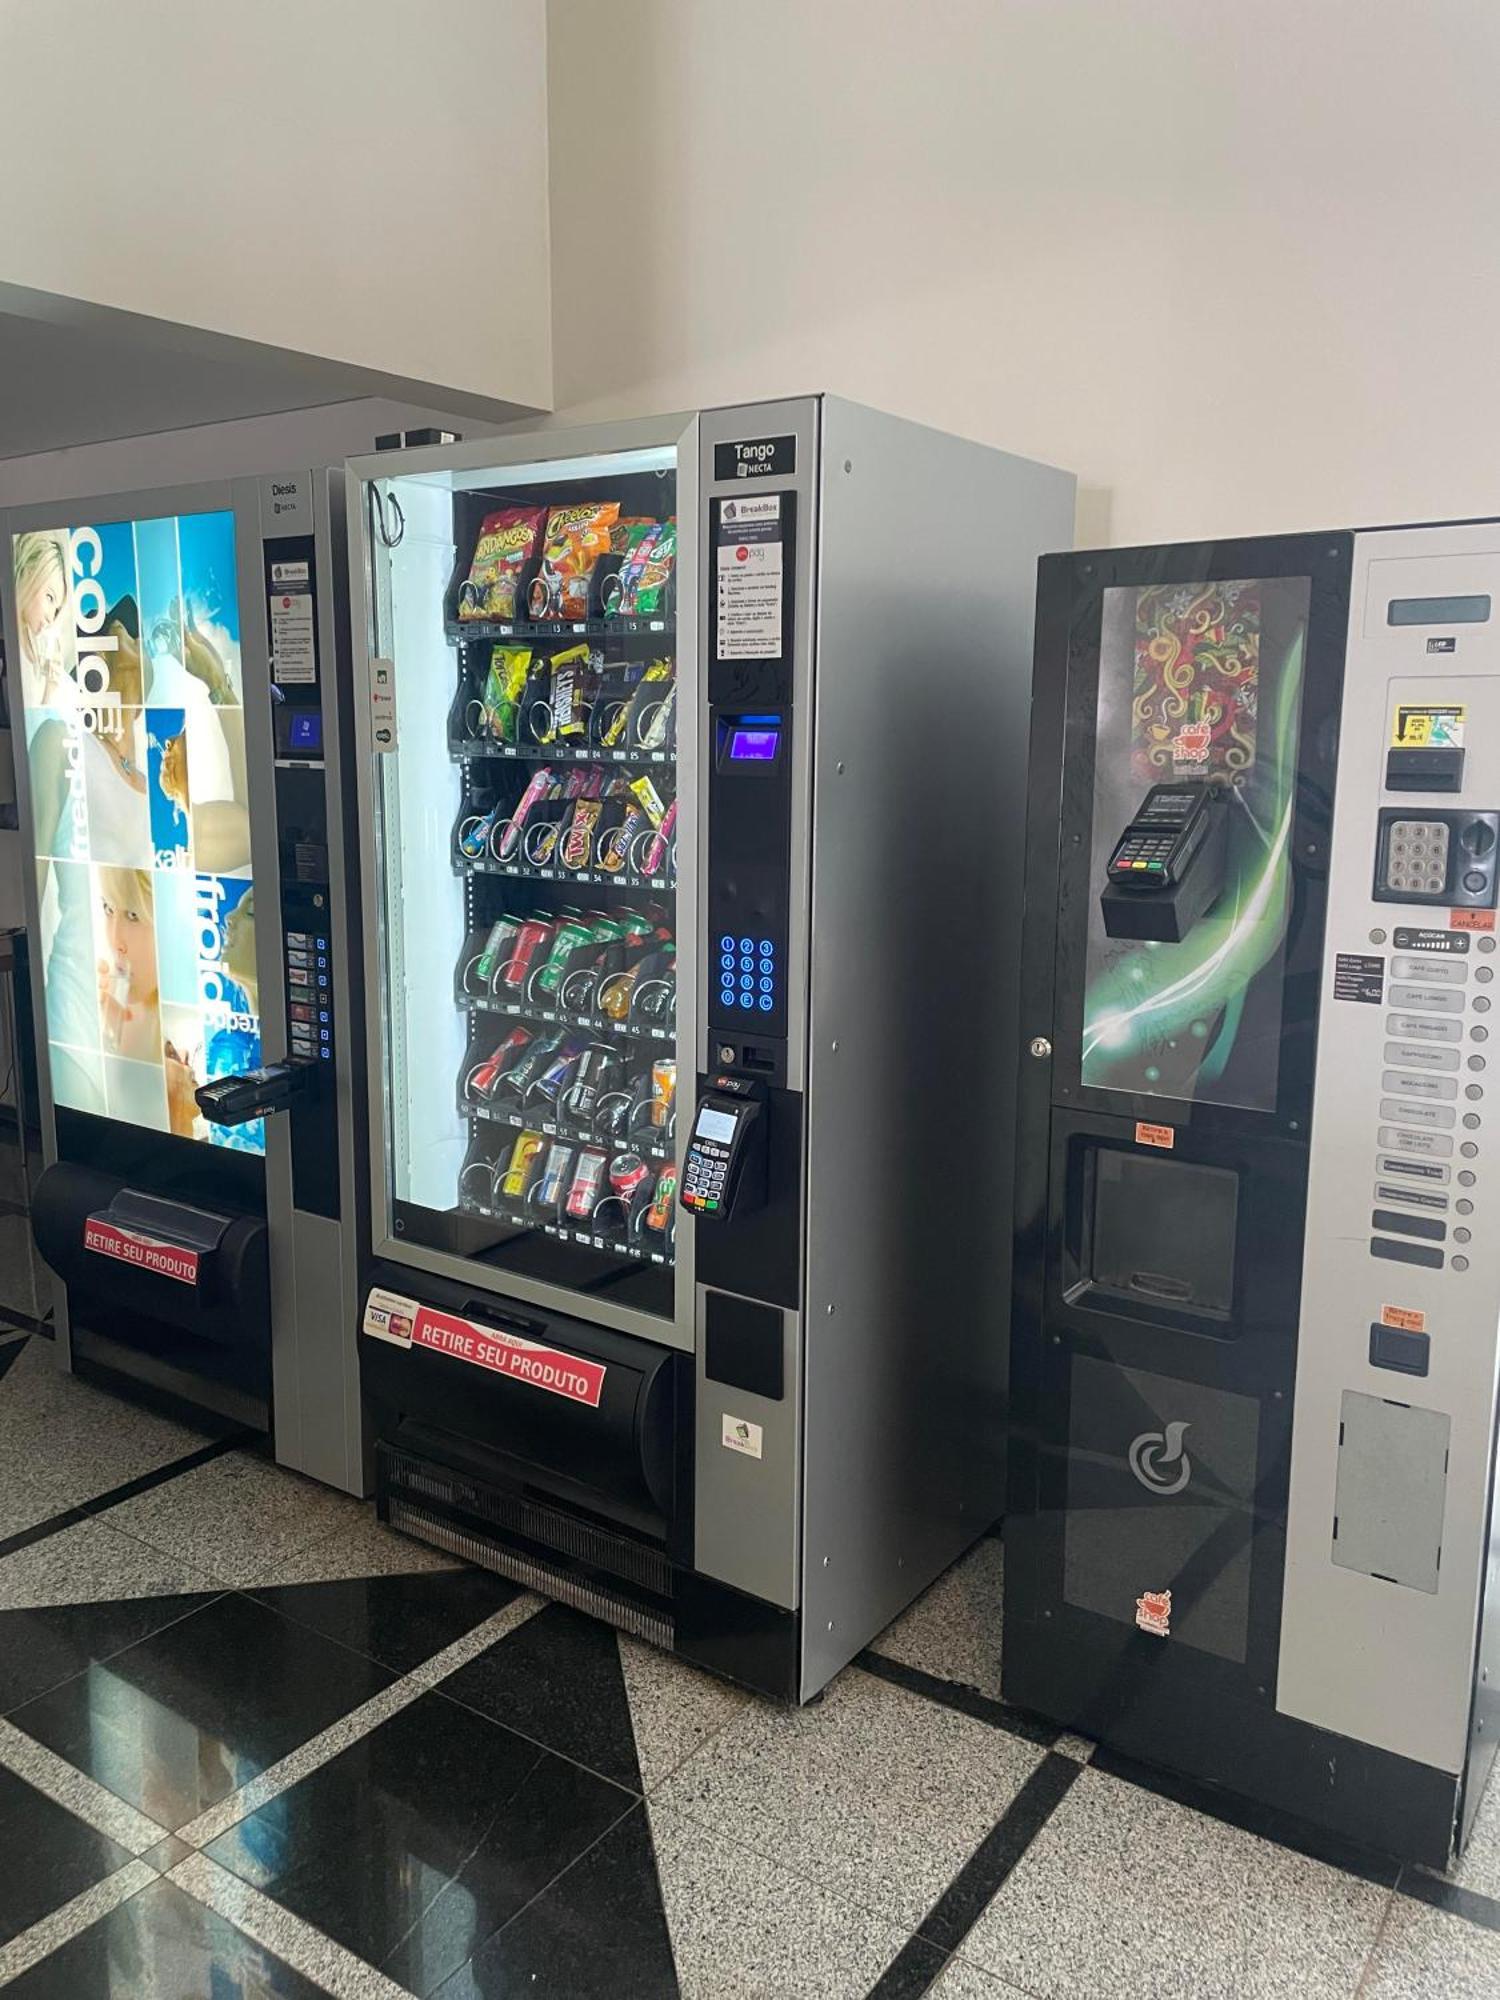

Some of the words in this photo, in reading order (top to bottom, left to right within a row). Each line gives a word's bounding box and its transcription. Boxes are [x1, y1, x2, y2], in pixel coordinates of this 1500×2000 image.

[734, 443, 775, 461] Tango
[748, 463, 773, 474] NECTA
[272, 482, 297, 497] Diesis
[70, 527, 122, 706] cold
[195, 876, 231, 1011] froid
[86, 1231, 121, 1255] RETIRE
[123, 1243, 144, 1261] SEU
[146, 1250, 196, 1280] PRODUTO
[371, 1311, 387, 1325] VISA
[422, 1323, 473, 1356] RETIRE
[476, 1343, 507, 1367] SEU
[511, 1354, 589, 1396] PRODUTO
